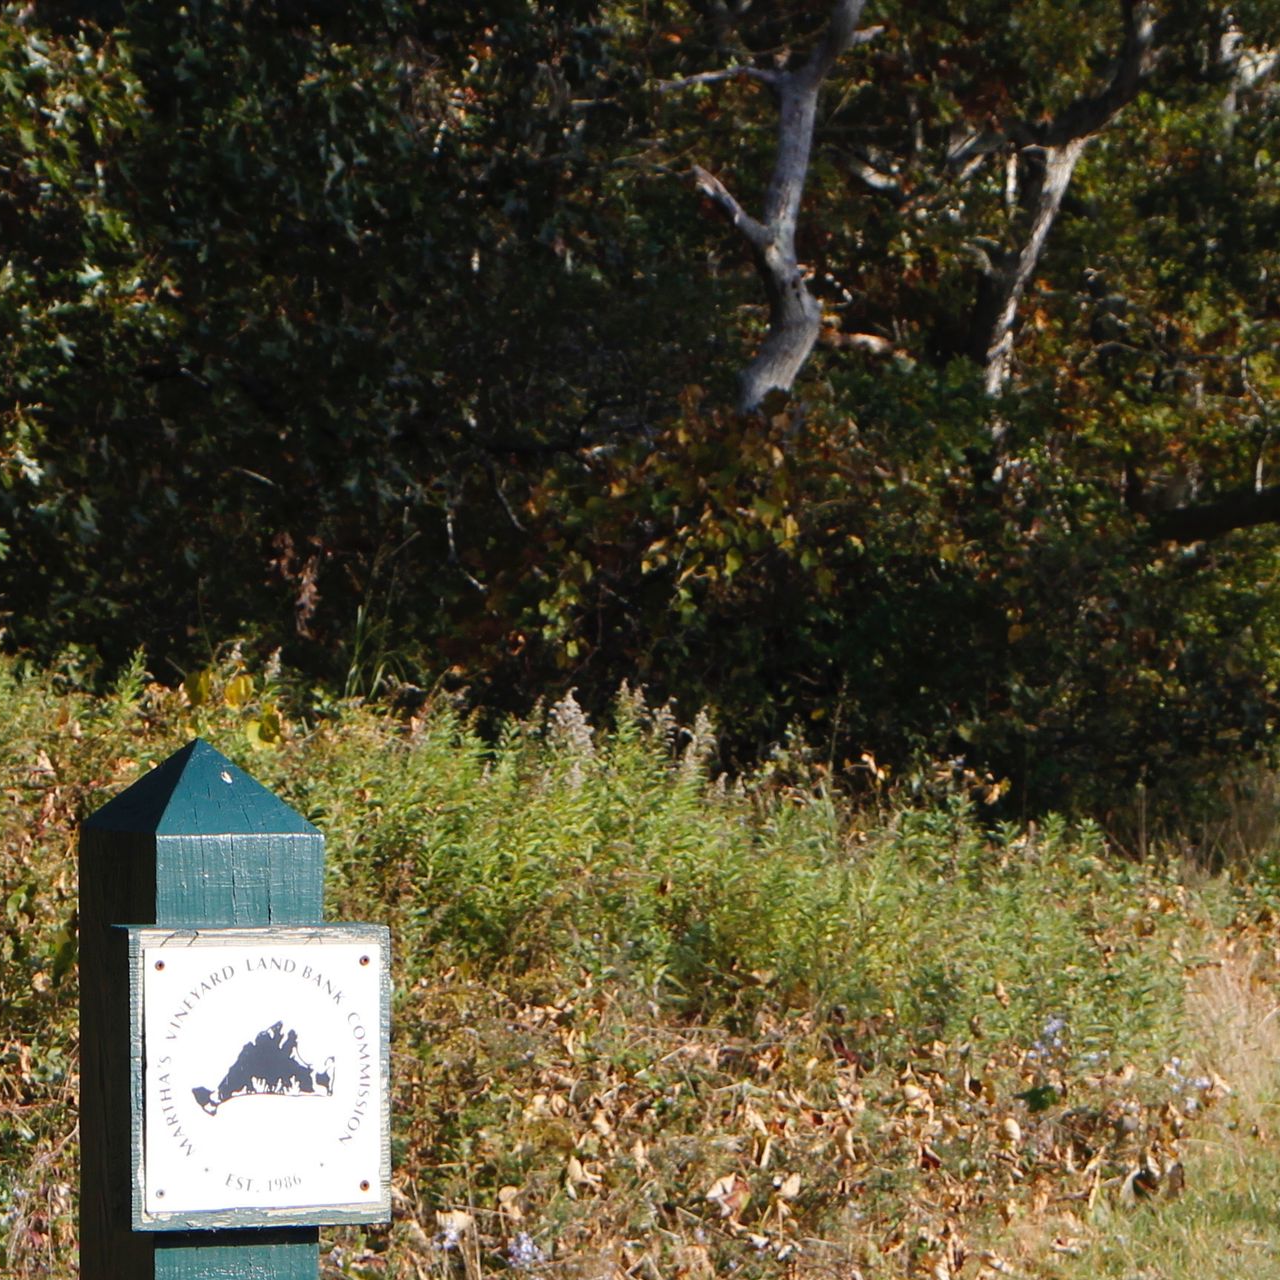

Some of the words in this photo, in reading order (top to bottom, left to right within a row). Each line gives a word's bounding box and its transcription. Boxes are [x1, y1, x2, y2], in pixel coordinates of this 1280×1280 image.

[245, 956, 296, 974] LAND
[302, 966, 346, 1006] BANK
[166, 965, 235, 1041] VINEYARD
[157, 1055, 195, 1157] MARTHA'S
[338, 1012, 373, 1147] COMMISSION
[225, 1172, 260, 1193] EST.
[267, 1175, 302, 1193] 1986
